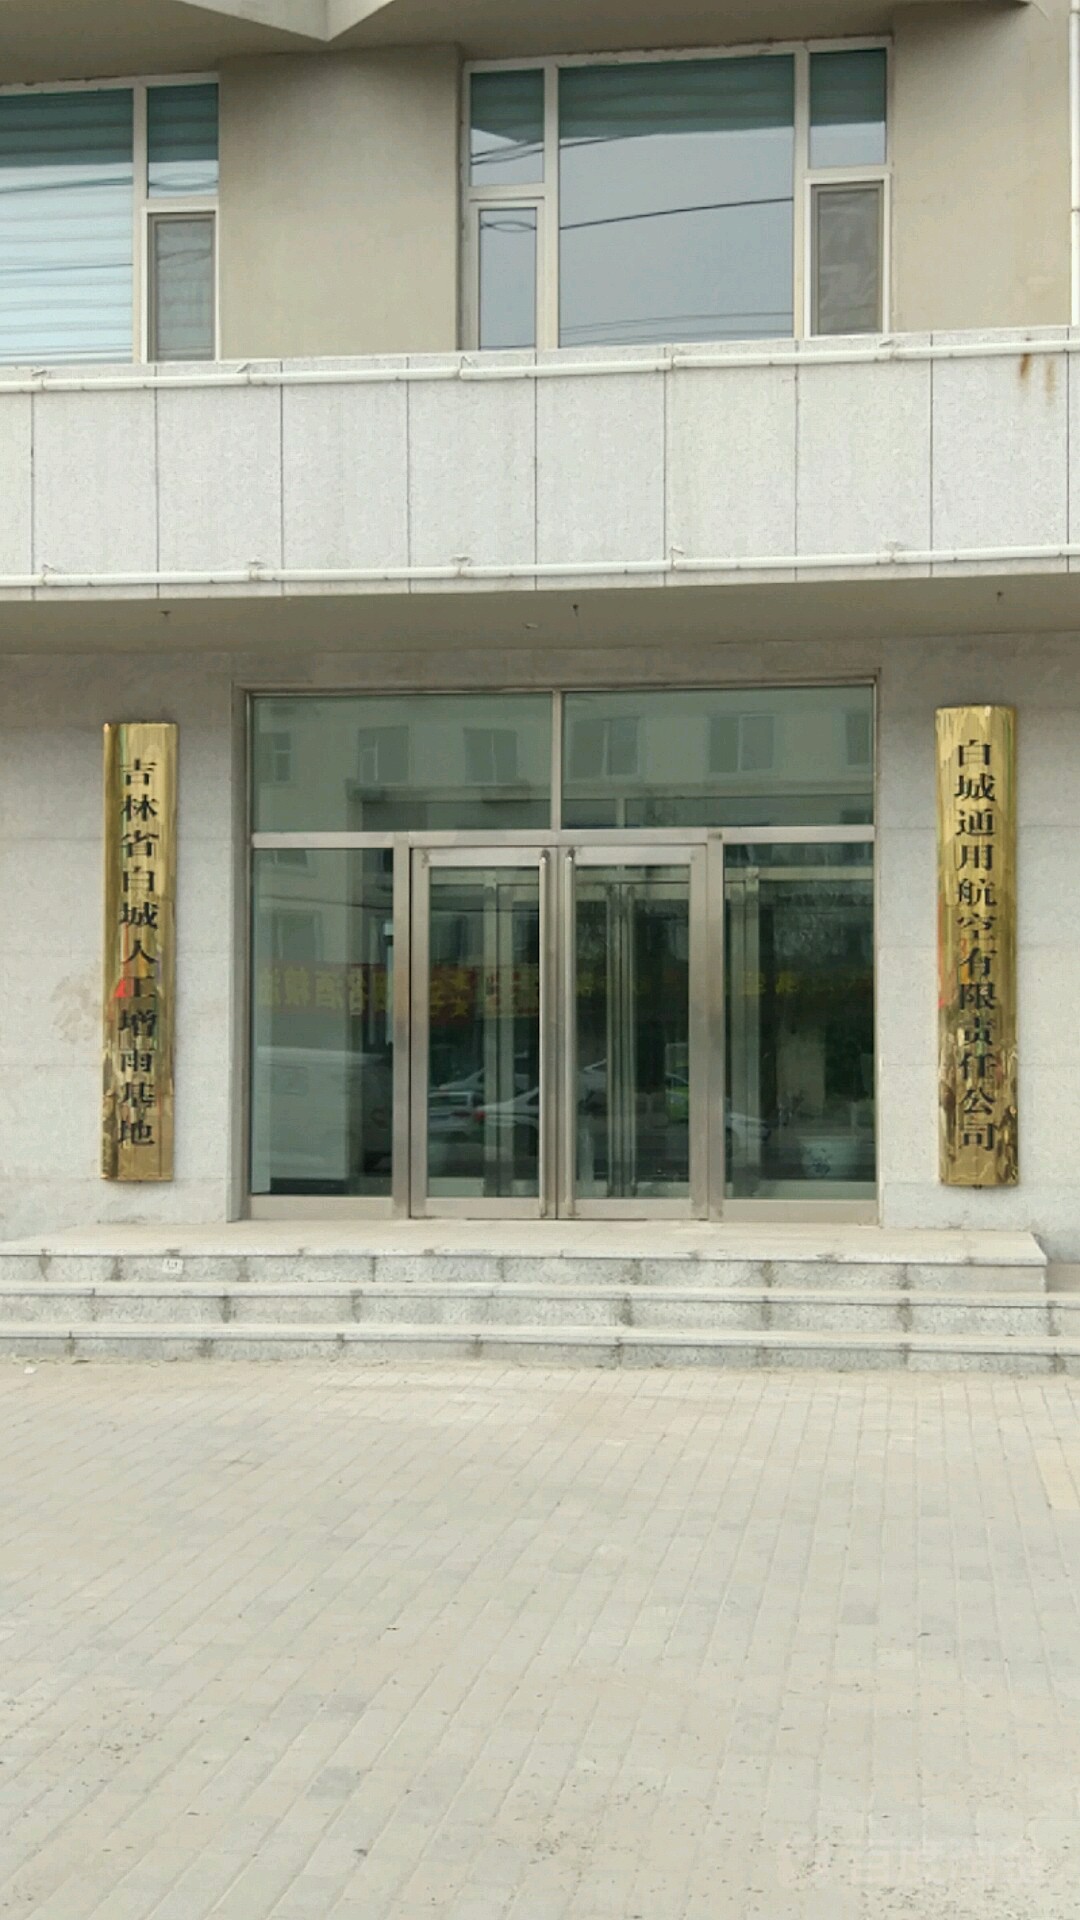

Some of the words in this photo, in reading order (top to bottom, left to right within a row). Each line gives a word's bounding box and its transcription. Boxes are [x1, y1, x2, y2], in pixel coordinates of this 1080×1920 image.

[117, 758, 160, 1146] 吉林省白城人工增雨基地
[953, 738, 999, 1151] 白城通用航空有限责任公司
